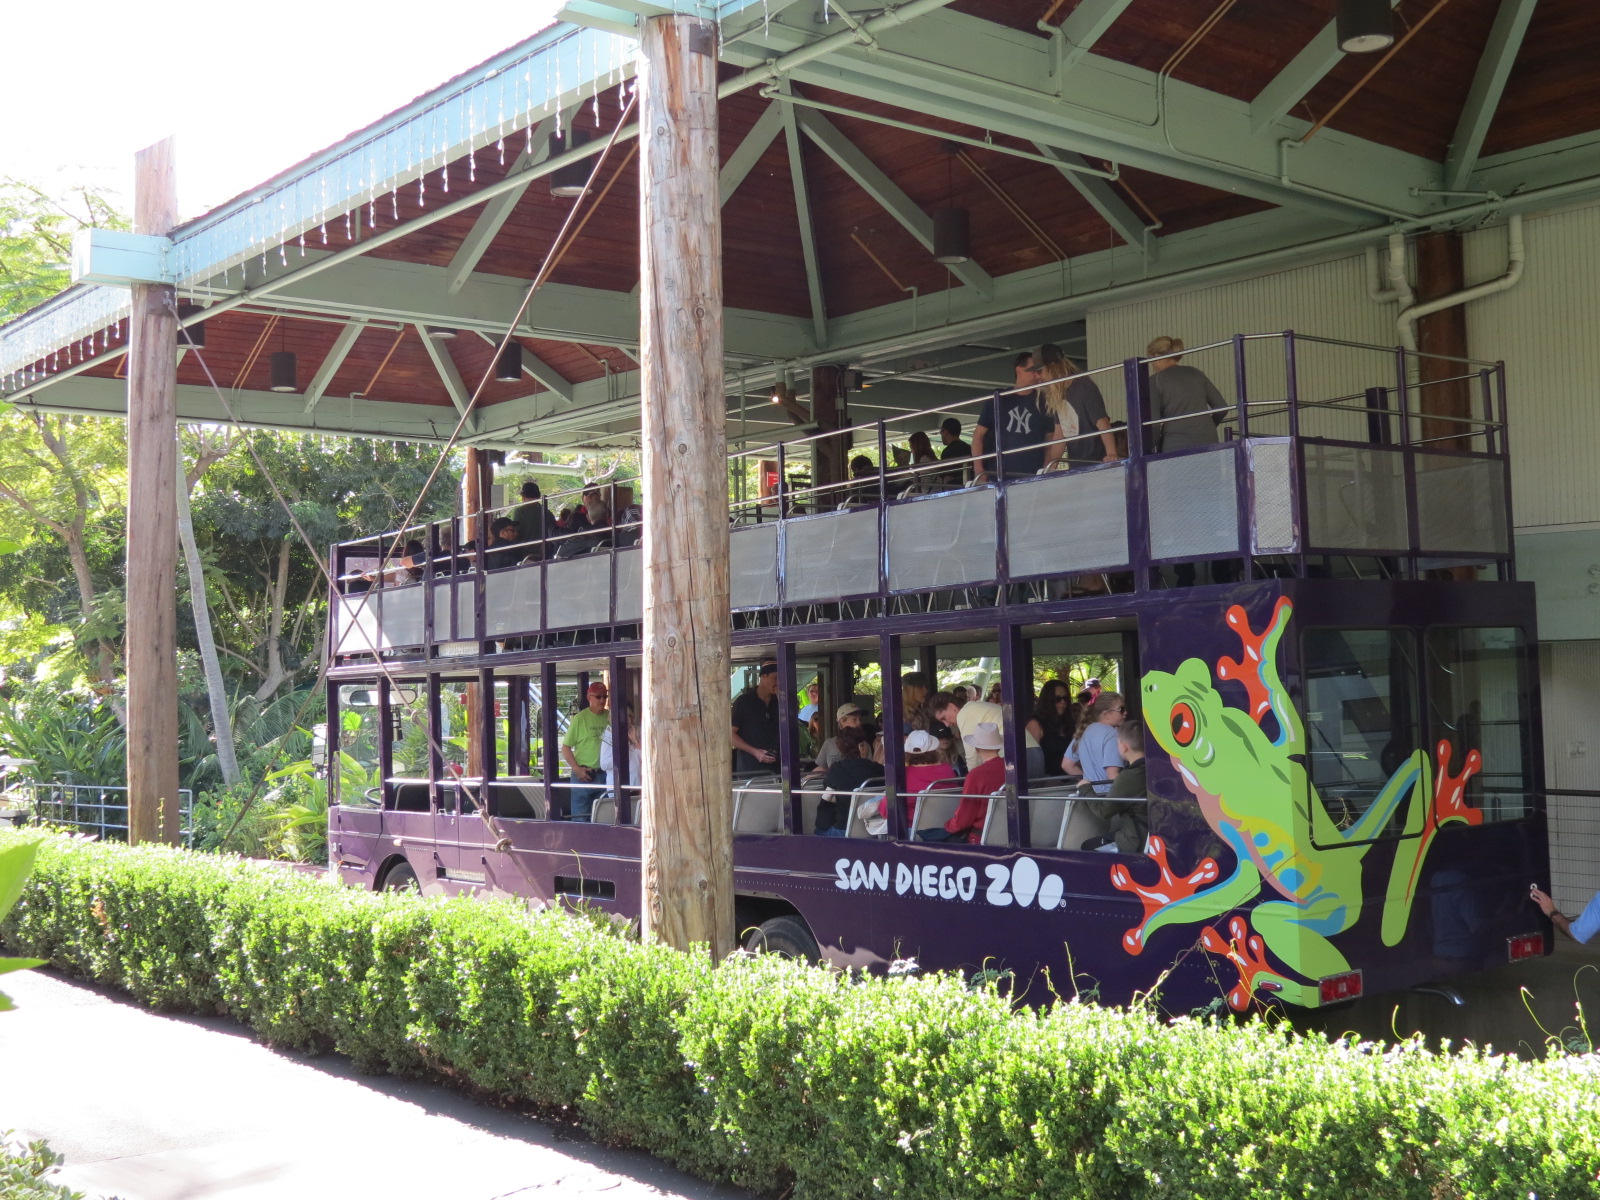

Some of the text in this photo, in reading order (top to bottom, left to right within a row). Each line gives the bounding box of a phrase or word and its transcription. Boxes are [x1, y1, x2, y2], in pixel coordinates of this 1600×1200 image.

[1006, 406, 1032, 434] NY
[835, 856, 1064, 910] SAN DIEGO ZOO
